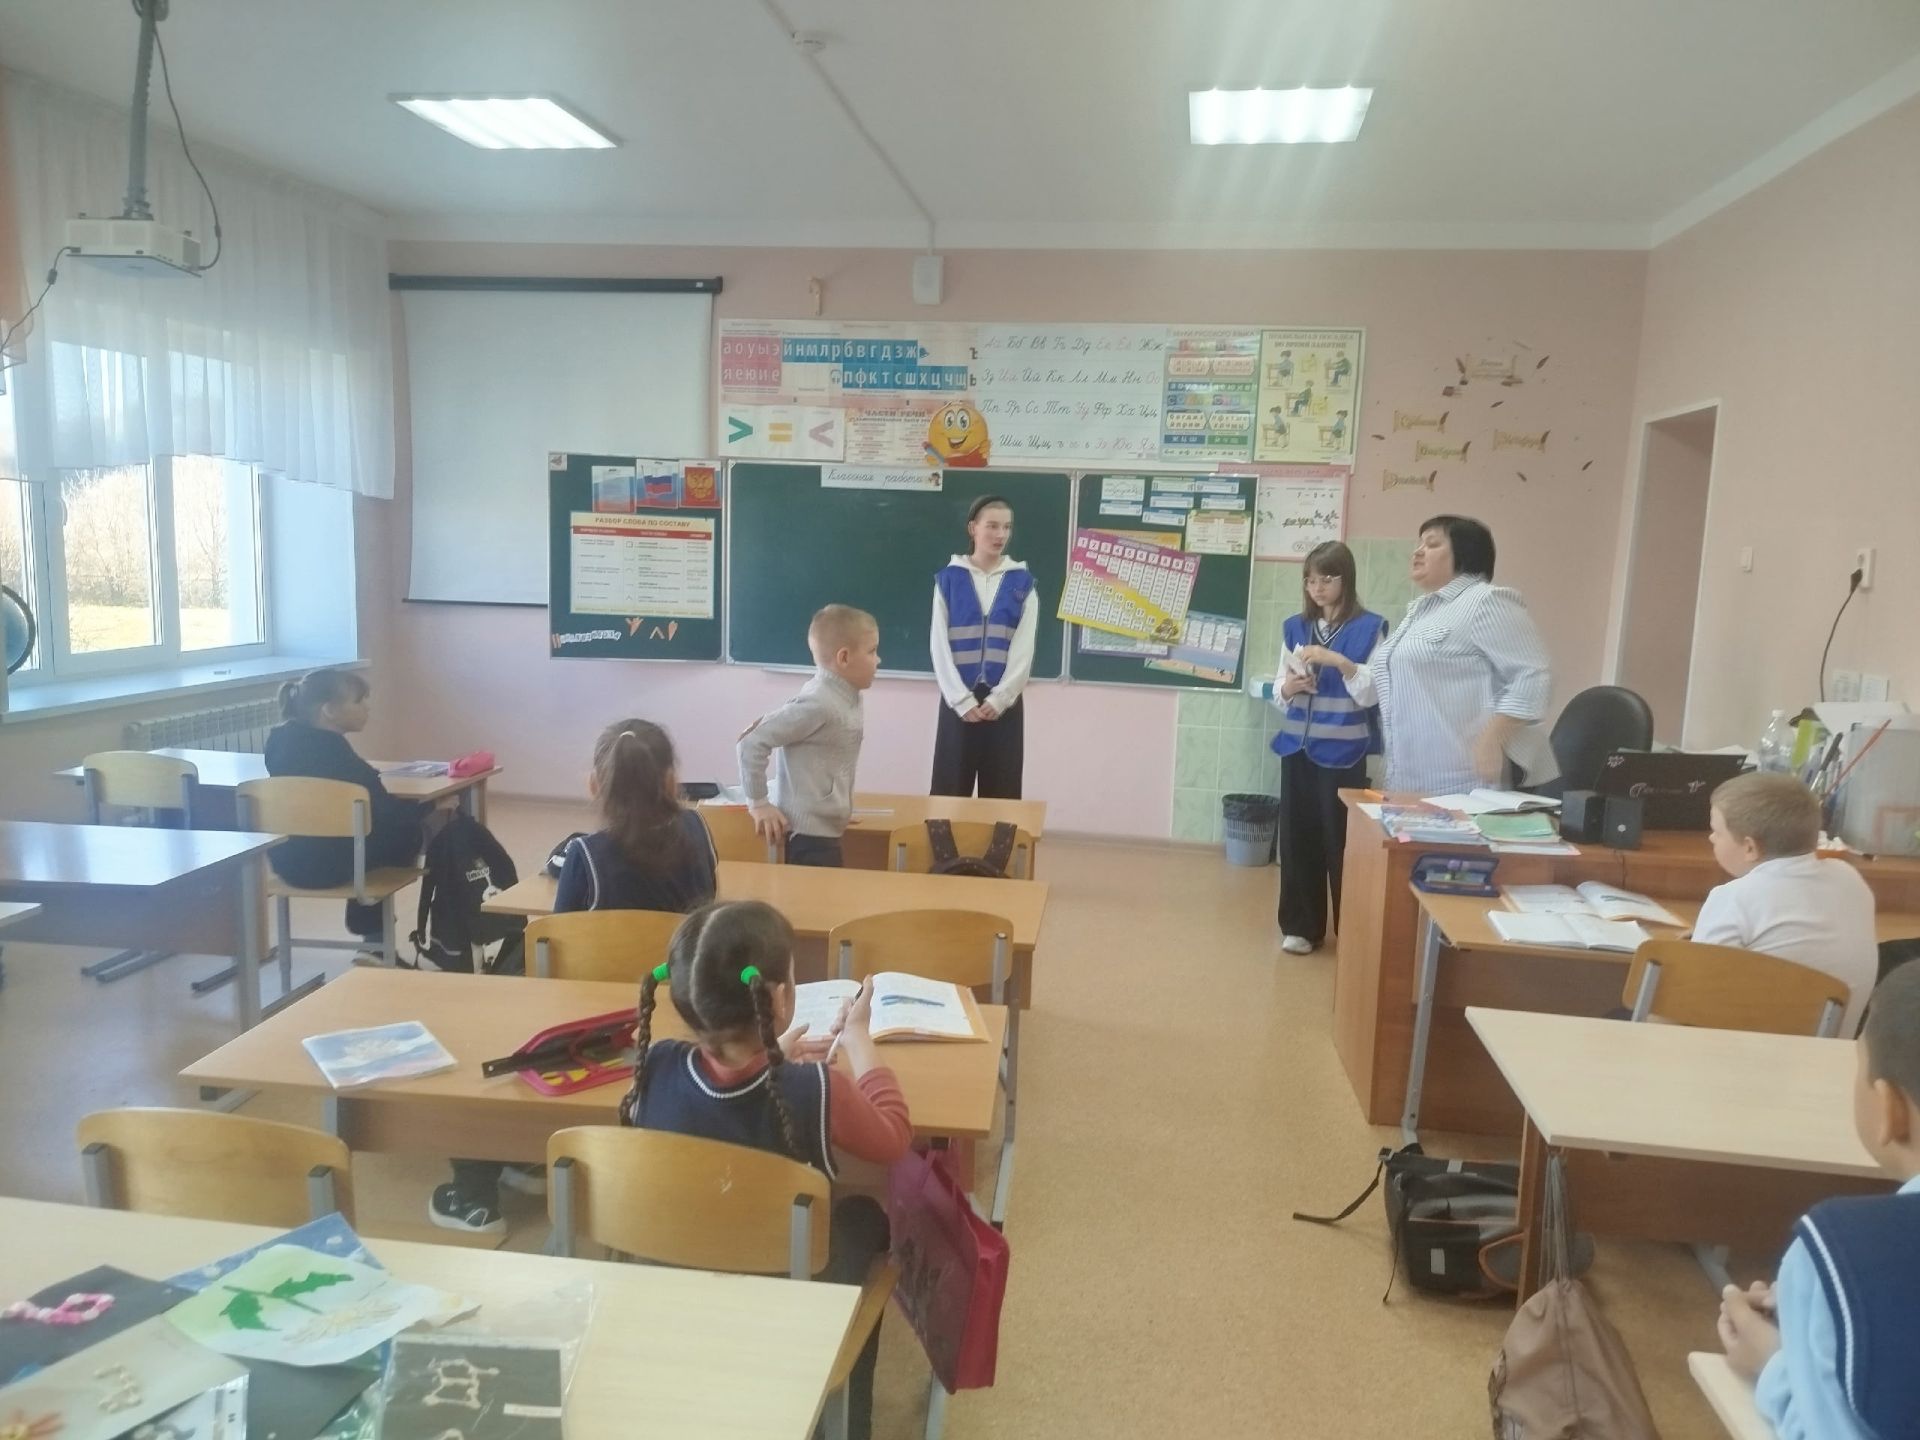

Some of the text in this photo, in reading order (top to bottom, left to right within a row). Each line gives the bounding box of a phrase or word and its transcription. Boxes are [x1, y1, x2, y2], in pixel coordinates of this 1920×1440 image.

[828, 468, 923, 487] Классная работа
[623, 518, 646, 526] СЛОВА
[659, 520, 690, 528] СОСТАВУ
